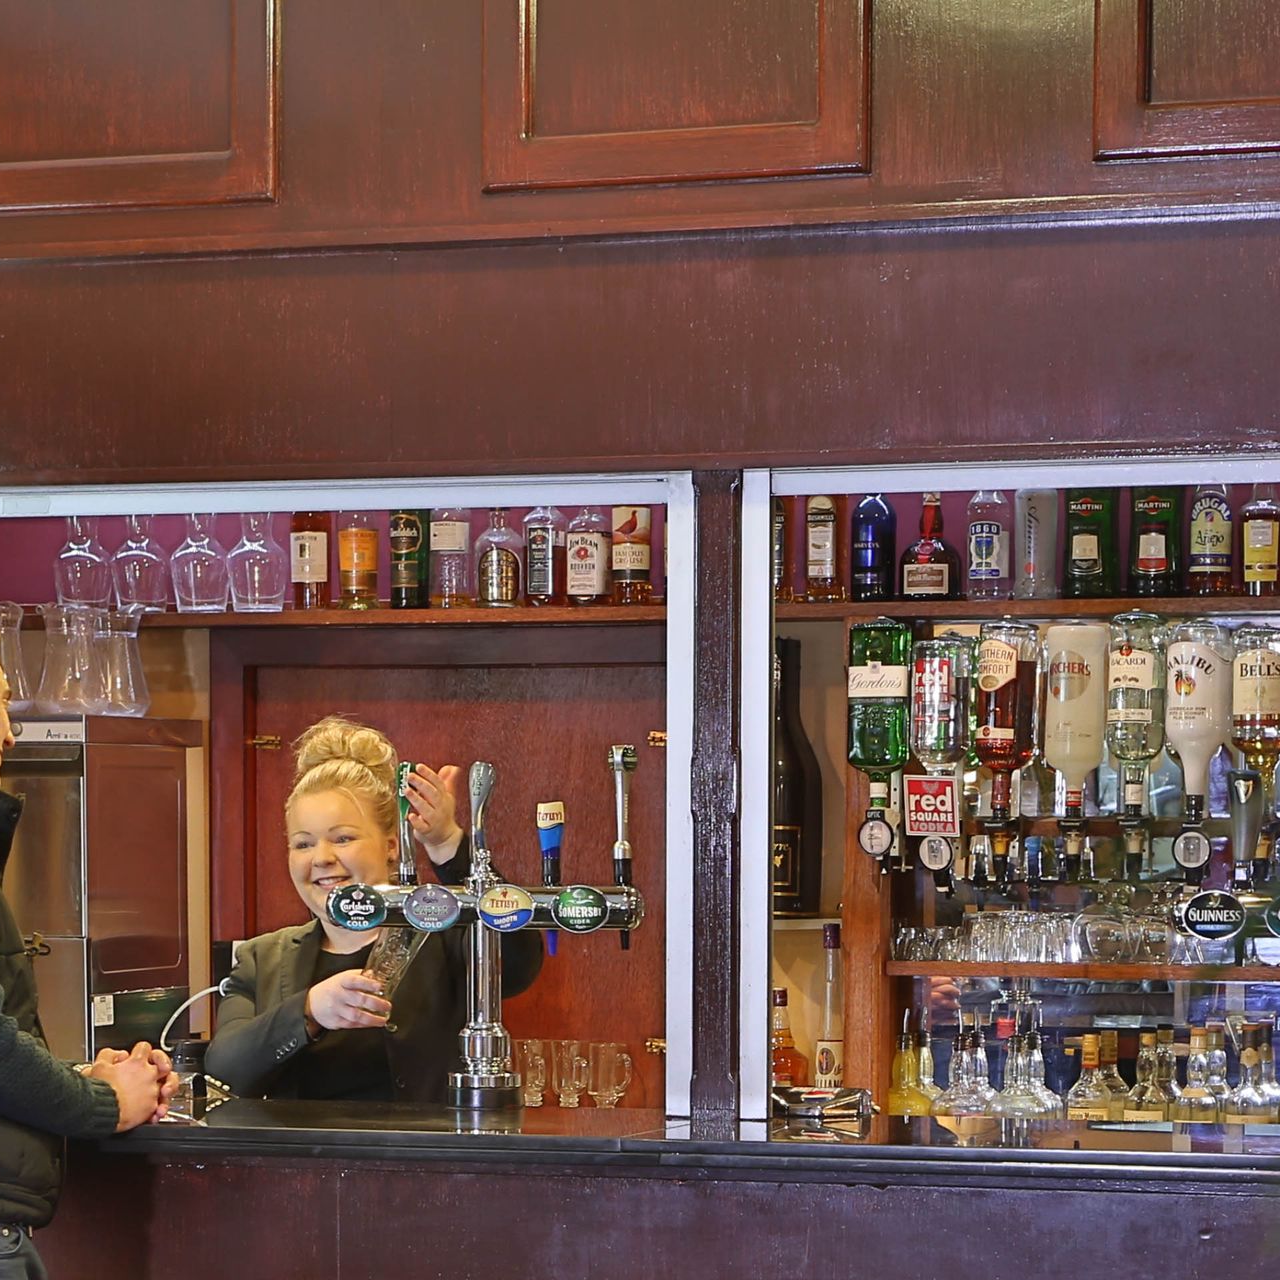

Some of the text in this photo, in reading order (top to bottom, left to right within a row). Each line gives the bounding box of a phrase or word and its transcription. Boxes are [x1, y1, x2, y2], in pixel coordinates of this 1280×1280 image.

[1070, 503, 1103, 511] MARTINI
[1138, 501, 1171, 509] MARTINI
[1192, 498, 1230, 520] BRUGAL
[970, 524, 998, 534] 1860
[569, 536, 599, 551] JIM BEAM
[1111, 657, 1147, 666] BACARDI
[1167, 653, 1216, 676] MALIBU
[849, 673, 903, 691] Gordon's
[909, 785, 954, 812] red
[867, 811, 882, 819] OPTIC
[910, 811, 954, 823] SQUARE
[911, 821, 955, 834] VODKA
[340, 899, 375, 916] Carlsberg
[412, 904, 449, 917] Export
[558, 903, 602, 918] SOMERSBY
[493, 914, 518, 926] SMOOTH
[1188, 907, 1242, 922] GUINNESS
[419, 920, 443, 928] COLD
